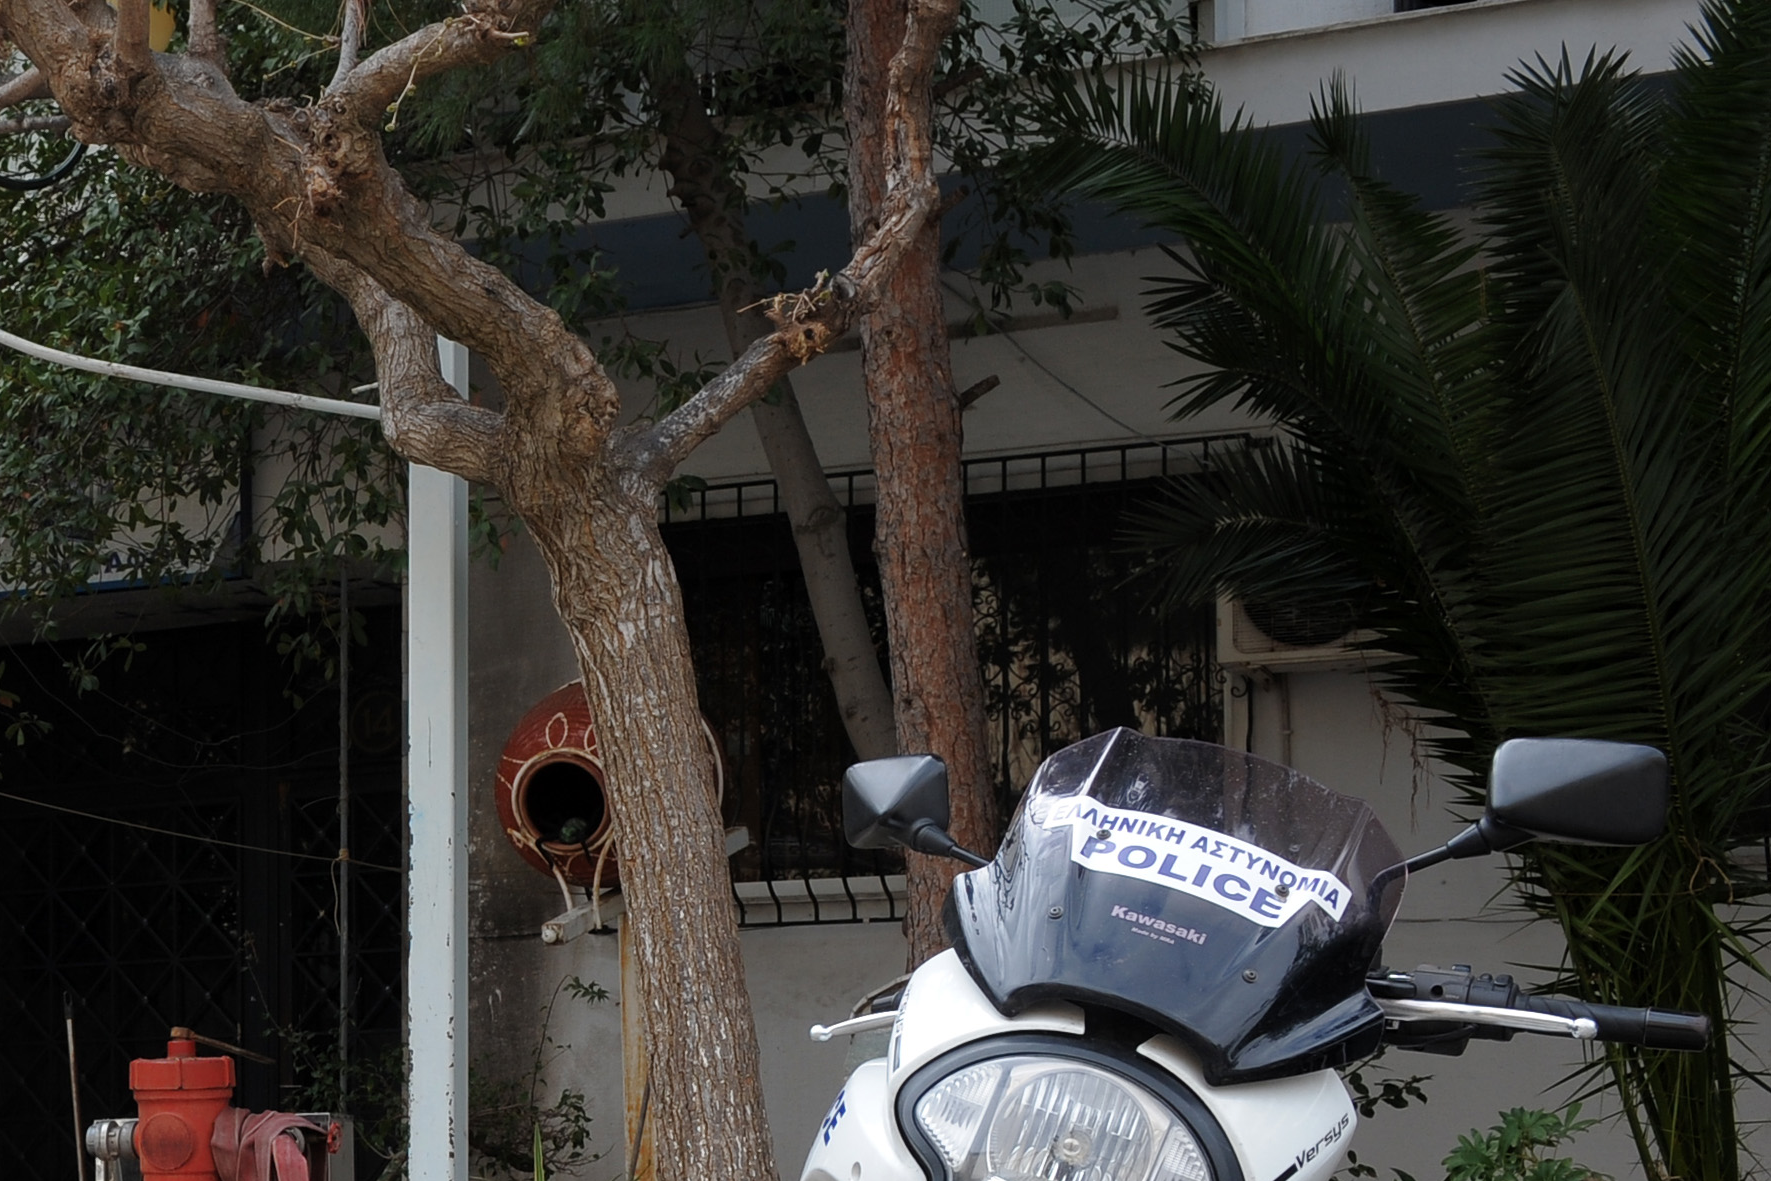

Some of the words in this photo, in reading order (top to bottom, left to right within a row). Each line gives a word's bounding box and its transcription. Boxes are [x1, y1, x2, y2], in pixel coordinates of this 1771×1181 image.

[1080, 835, 1288, 919] POLICE
[1190, 836, 1340, 910] ΑΣΤΥΝΟΜΙΑ
[1110, 904, 1208, 946] Kawasaki
[1295, 1112, 1350, 1169] Versys
